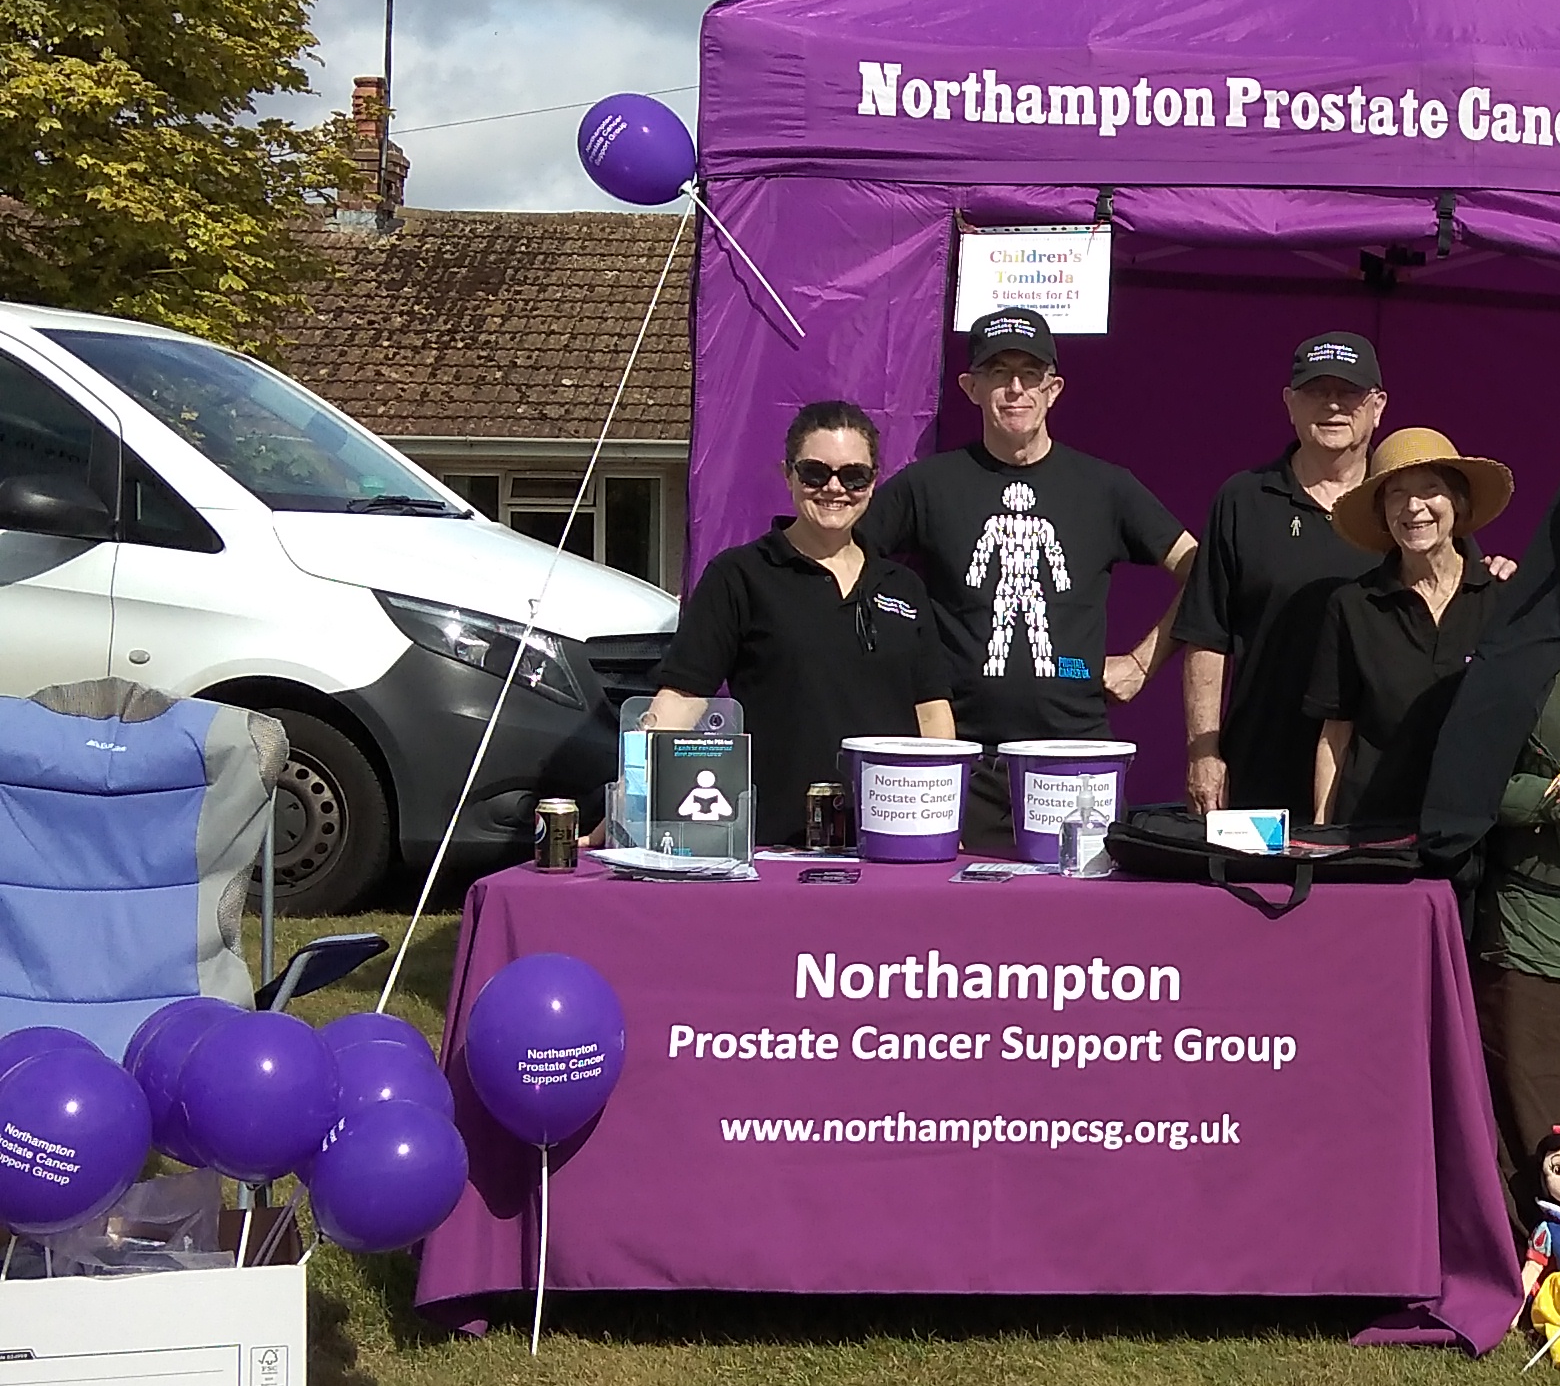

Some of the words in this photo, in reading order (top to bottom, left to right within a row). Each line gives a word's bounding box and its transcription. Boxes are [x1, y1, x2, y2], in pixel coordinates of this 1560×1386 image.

[857, 61, 1215, 137] Northampton
[1225, 76, 1448, 139] Prostate
[602, 115, 622, 136] Cancer
[608, 122, 627, 141] Group
[990, 249, 1082, 263] Children's
[995, 270, 1074, 284] Tombola
[992, 290, 999, 299] 5
[1003, 290, 1042, 300] tickets
[1046, 290, 1062, 300] for
[1066, 290, 1080, 300] £1
[875, 774, 953, 790] Northampton
[869, 790, 916, 803] Prostate
[920, 793, 957, 803] Cancer
[1027, 794, 1074, 808] Prostate
[871, 806, 917, 821] Support
[920, 809, 954, 820] Group
[1029, 810, 1067, 825] Suppo
[796, 950, 1181, 1011] Northampton
[527, 1043, 597, 1059] Northampton
[668, 1024, 839, 1062] Prostate
[851, 1025, 990, 1061] Cancer
[1001, 1026, 1161, 1068] Support
[1173, 1029, 1297, 1069] Group
[518, 1058, 565, 1072] Prostate
[569, 1053, 605, 1069] Cancer
[522, 1074, 567, 1085] Support
[570, 1067, 602, 1081] Group
[721, 1112, 1241, 1149] www.northamptonpcsg.org.uk
[4, 1122, 76, 1158] Northampton
[0, 1134, 34, 1159] rostate
[36, 1153, 81, 1173] Cancer
[33, 1166, 70, 1185] Group
